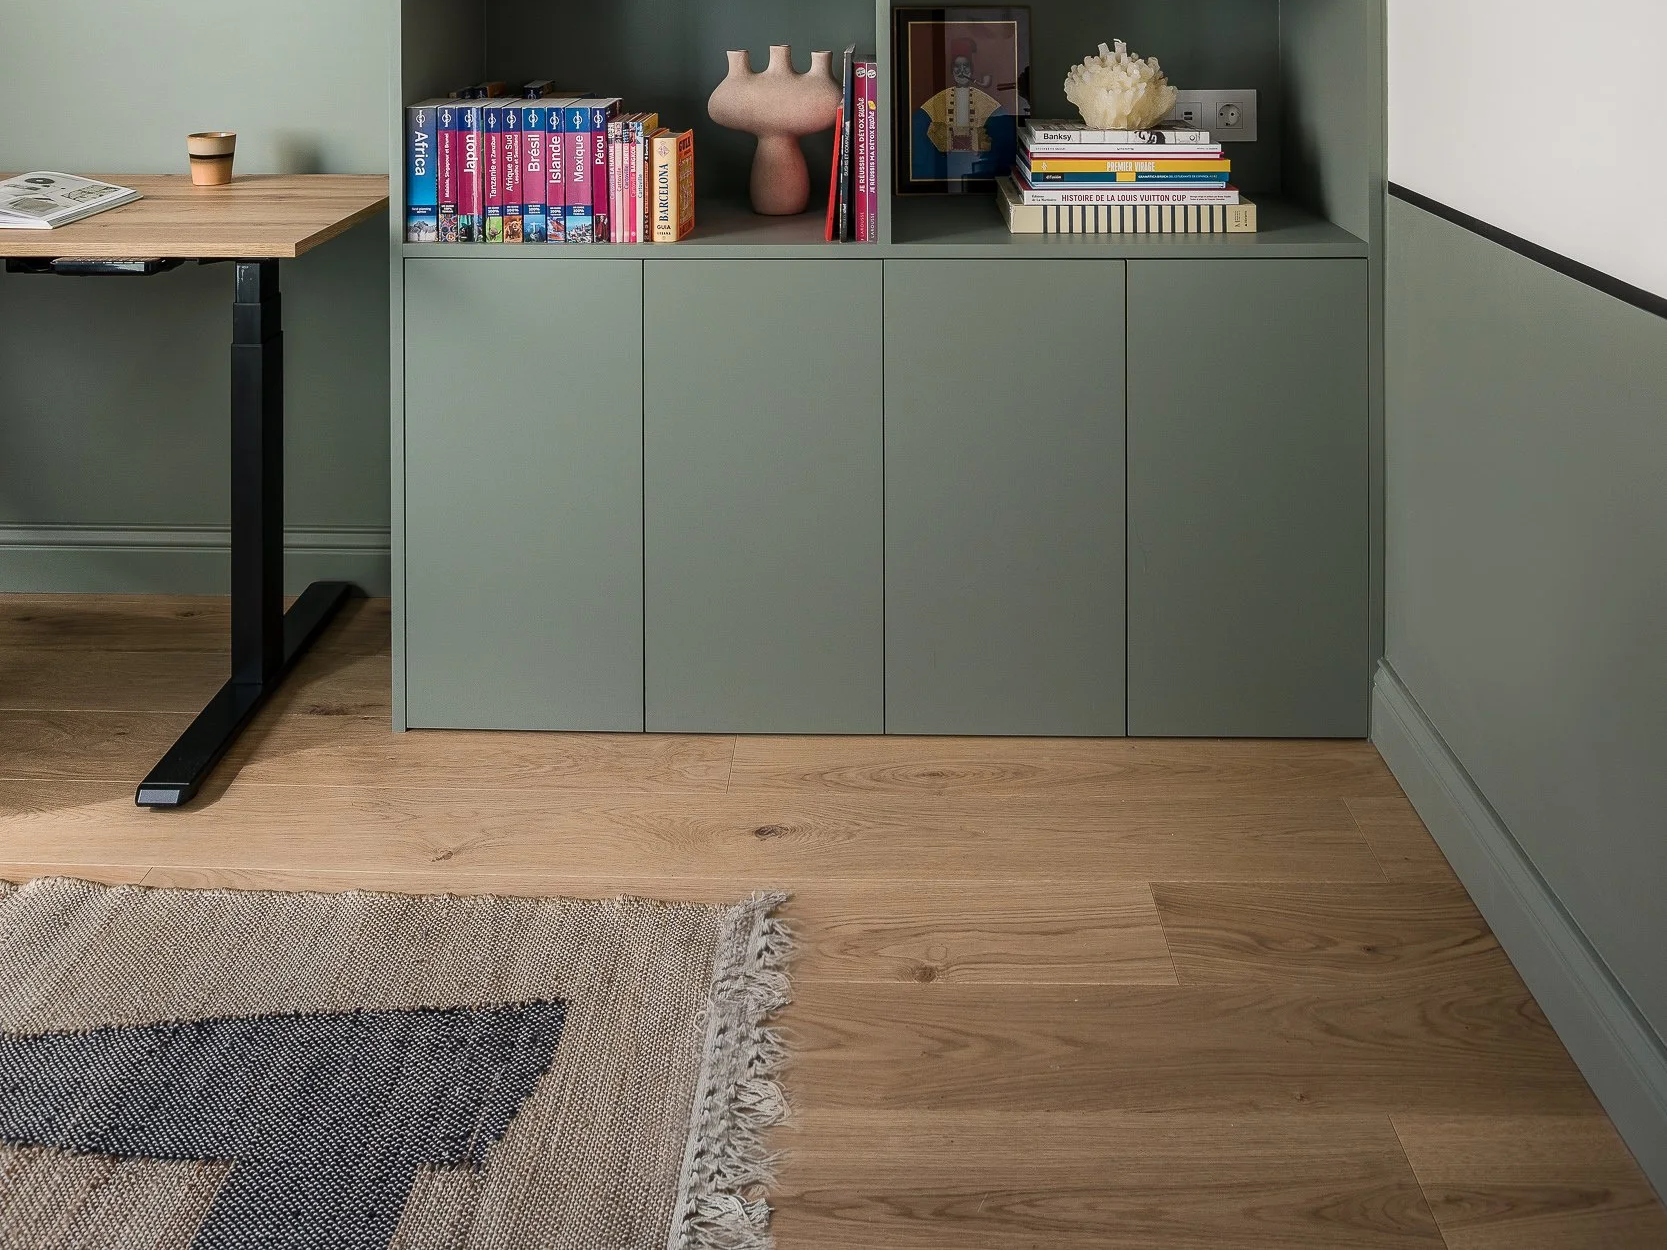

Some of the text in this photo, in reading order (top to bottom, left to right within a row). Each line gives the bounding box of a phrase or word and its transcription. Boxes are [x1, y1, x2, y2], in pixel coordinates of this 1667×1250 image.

[505, 134, 513, 150] Sud
[1043, 133, 1072, 141] Banksy
[415, 131, 428, 176] Africa
[464, 134, 478, 173] Japon
[505, 151, 513, 161] du
[528, 134, 540, 171] Brésil
[549, 136, 561, 183] Islande
[574, 135, 584, 182] Mexique
[595, 135, 604, 164] Pérou
[859, 143, 865, 154] MA
[869, 151, 875, 161] MA
[505, 162, 514, 192] Afrique
[1106, 161, 1155, 172] PREMIER VIRAGE
[489, 165, 497, 198] Tanzanie
[658, 163, 668, 221] BARCELONA
[859, 184, 865, 193] JE
[870, 186, 876, 194] JE
[1061, 194, 1093, 202] HISTOIRE
[1096, 194, 1104, 202] DE
[1106, 194, 1116, 202] LA
[1117, 194, 1137, 202] LOUIS
